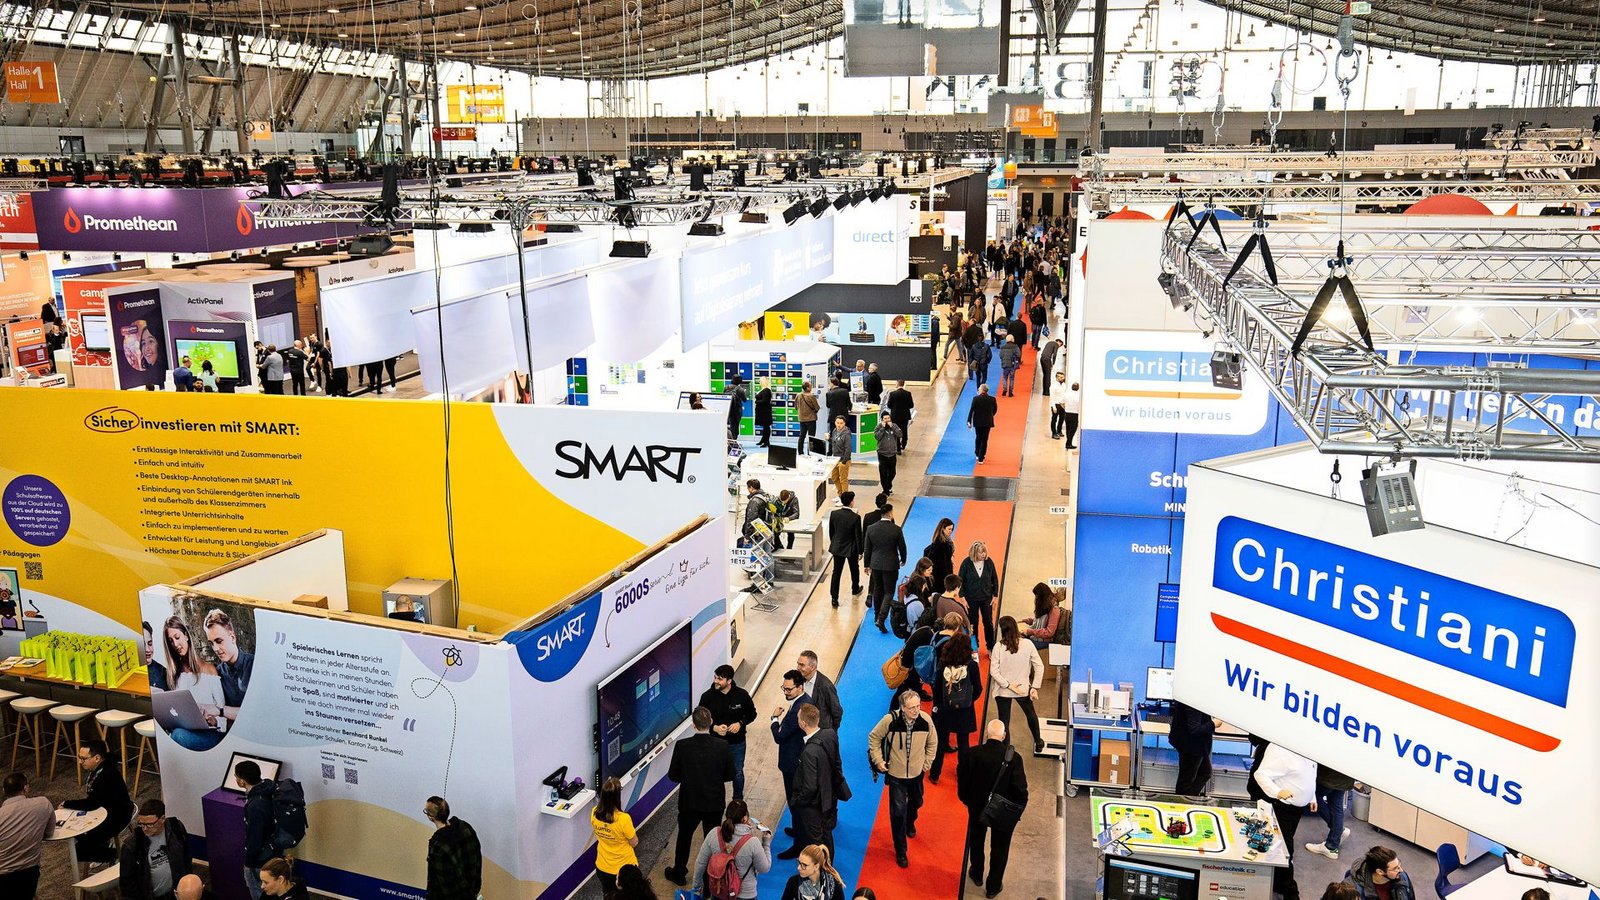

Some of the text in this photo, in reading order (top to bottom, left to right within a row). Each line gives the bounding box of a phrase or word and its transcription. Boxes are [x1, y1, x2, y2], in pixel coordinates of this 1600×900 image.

[8, 65, 44, 90] Halle 1
[10, 80, 27, 90] Hall
[84, 214, 178, 232] Promethean
[852, 230, 895, 243] direct
[333, 276, 354, 285] Proethean
[187, 297, 224, 305] ActivPanel
[254, 288, 274, 300] ctivPanel
[124, 298, 155, 310] Promethean
[1112, 356, 1212, 378] Christia
[1112, 406, 1232, 421] Wir bilden voraus
[91, 414, 300, 436] Sicher investieren mit SMART:
[136, 446, 178, 456] Erstklassige
[179, 447, 224, 456] Interaktivität
[241, 450, 302, 460] Zusammenarbeit
[140, 472, 159, 480] Beste
[161, 473, 240, 484] Desktop-Annotationen
[254, 477, 280, 485] SMART
[282, 478, 293, 486] Ink
[142, 485, 181, 495] Einbindung
[197, 488, 264, 499] Schülerendgeräten
[266, 491, 300, 500] innerhalb
[158, 497, 194, 505] außerhalb
[210, 500, 266, 508] Klassenzimmers
[144, 509, 244, 520] Integrierte Unterrichtsinhalte
[182, 524, 237, 534] implementieren
[148, 534, 182, 542] Entwickelt
[195, 537, 224, 546] Leistung
[241, 540, 281, 548] Langlebigk
[3, 550, 40, 559] Pädagogen
[149, 546, 179, 555] Höchster
[181, 548, 224, 558] Datenschutz
[1131, 544, 1172, 555] Robotik
[615, 578, 649, 614] 6000S
[1232, 538, 1547, 678] Christiani
[537, 612, 586, 661] SMART
[292, 642, 383, 665] Spielerisches Lernen spricht
[286, 652, 319, 664] Menschen
[327, 659, 344, 669] jeder
[346, 662, 379, 675] Altersstufe
[286, 663, 298, 671] Das
[300, 666, 319, 675] merke
[321, 668, 330, 676] ich
[332, 670, 338, 678] in
[339, 673, 363, 682] meinen
[283, 673, 398, 700] Die Schülerinnen und Schüler haben
[284, 683, 300, 692] mehr
[302, 687, 321, 697] Spaß,
[322, 690, 335, 698] sind
[337, 693, 373, 706] motivierter
[375, 700, 387, 709] und
[291, 696, 306, 704] kann
[317, 700, 333, 709] doch
[335, 704, 356, 714] immer
[357, 708, 370, 716] mal
[372, 711, 394, 721] wieder
[305, 708, 382, 729] ins Staunen versetzen...
[302, 721, 388, 743] Sekundarlehrer Bernhard Runkel
[1224, 658, 1524, 805] Wir bilden voraus
[288, 728, 403, 756] (Hünenberger Schulen, Kanton Zug, Schweiz)
[1202, 864, 1245, 872] fischertechnik
